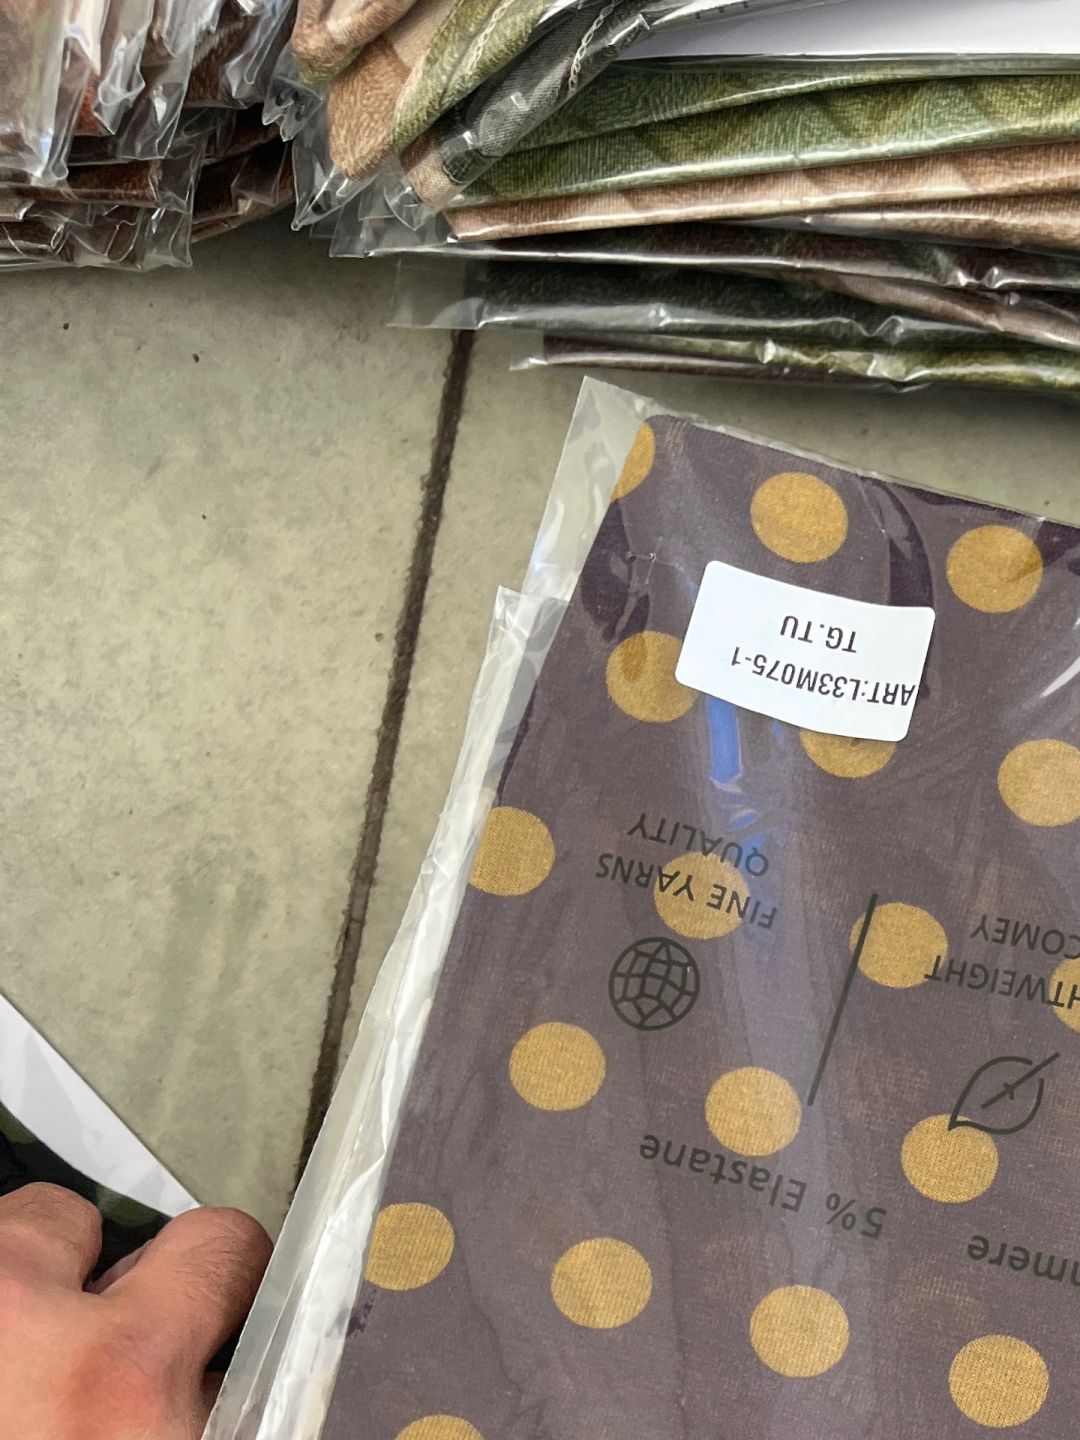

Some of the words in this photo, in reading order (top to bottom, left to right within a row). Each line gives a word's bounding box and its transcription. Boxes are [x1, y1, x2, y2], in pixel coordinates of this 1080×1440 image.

[731, 646, 916, 706] ART:L33M075-1
[627, 813, 768, 877] QUALITY
[596, 853, 694, 901] YARNS
[707, 884, 777, 930] FINE
[639, 1134, 807, 1212] Elastane
[825, 1193, 887, 1238] 5%
